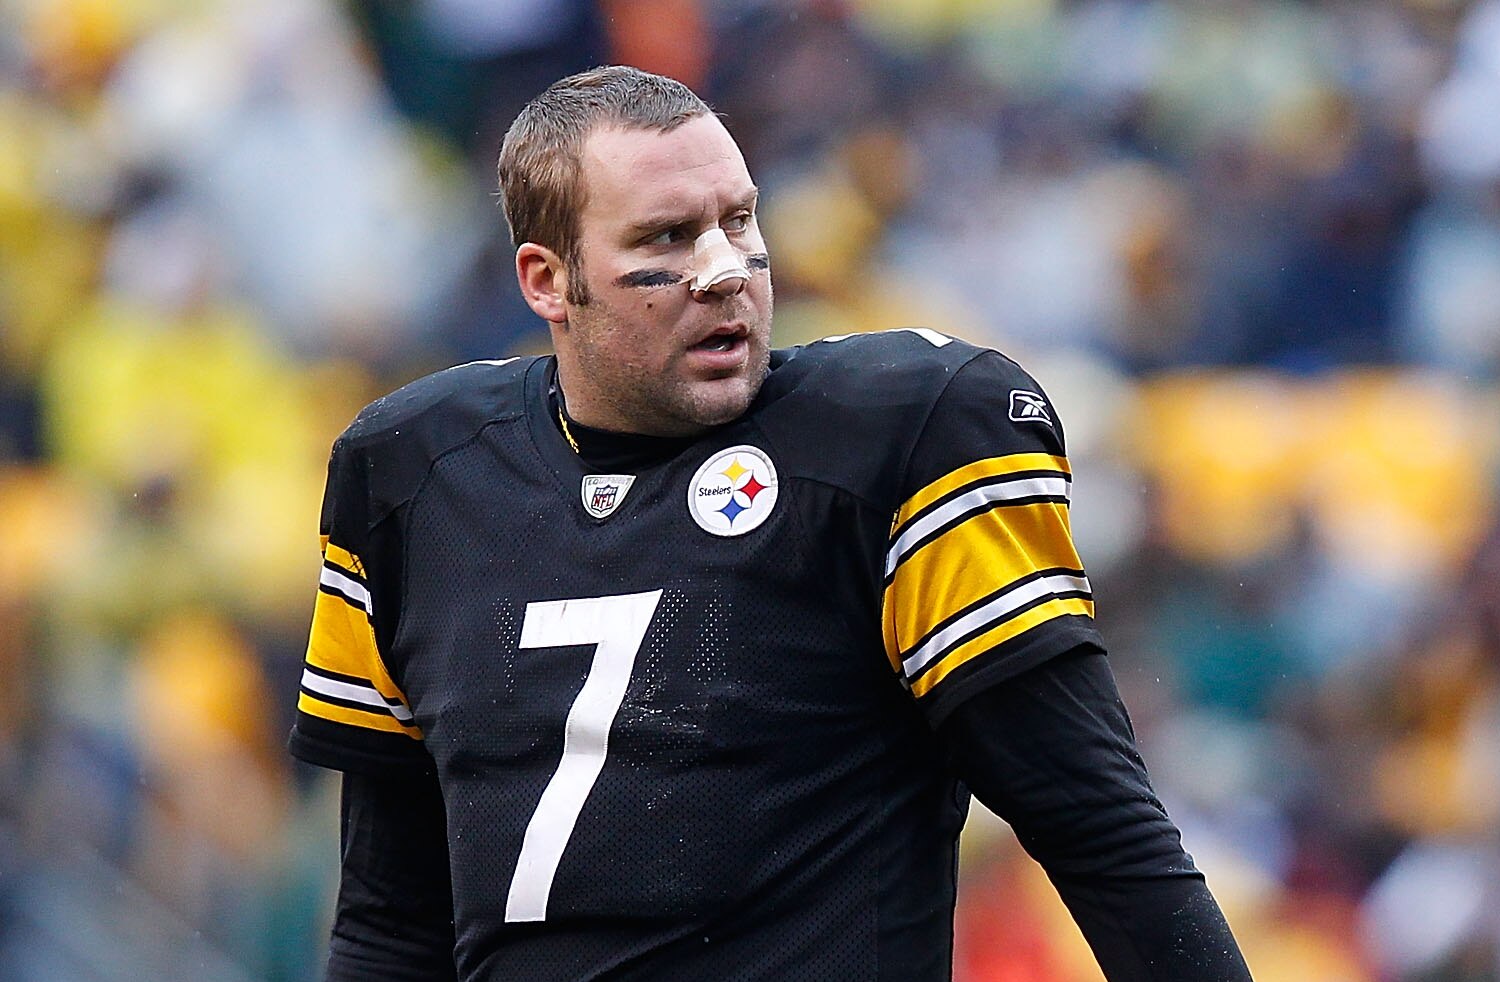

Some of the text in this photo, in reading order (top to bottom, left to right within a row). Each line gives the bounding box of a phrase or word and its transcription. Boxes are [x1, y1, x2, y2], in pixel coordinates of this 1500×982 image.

[698, 484, 731, 497] Steelers
[593, 494, 613, 509] NFL
[504, 588, 663, 923] 7
